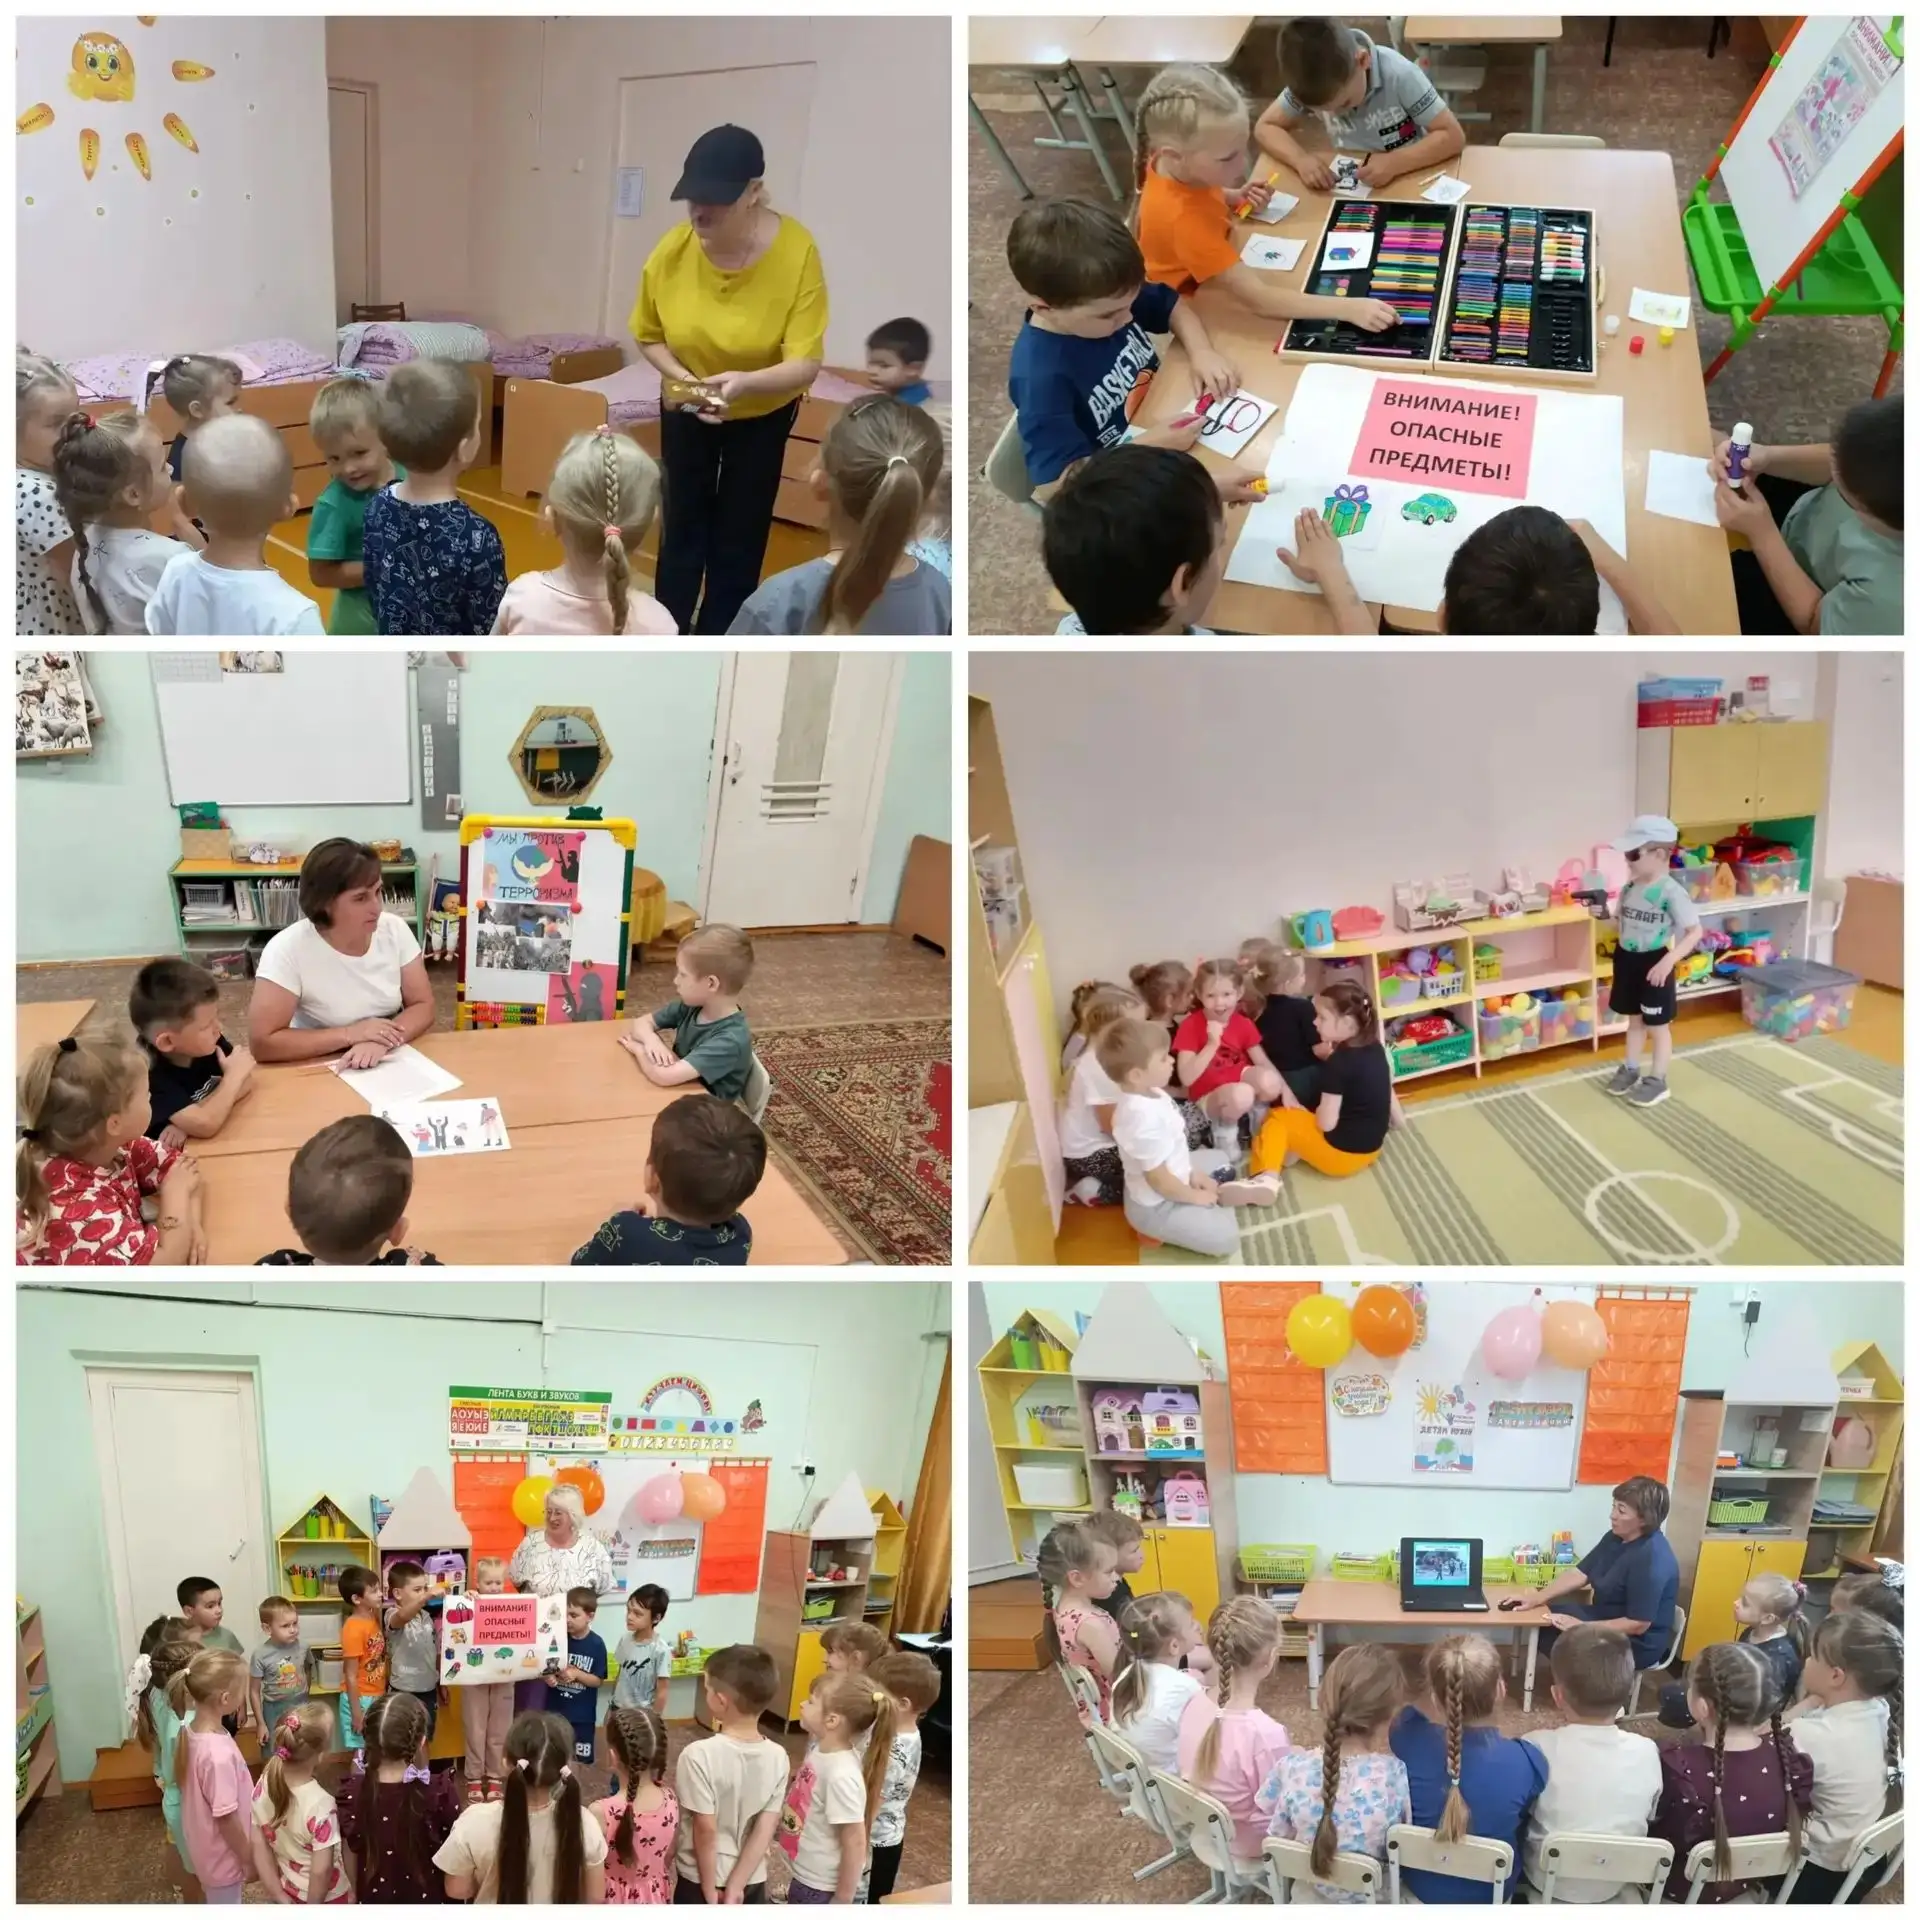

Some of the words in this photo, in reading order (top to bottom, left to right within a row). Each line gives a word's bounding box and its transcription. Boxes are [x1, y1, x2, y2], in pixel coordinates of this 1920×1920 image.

[1383, 392, 1521, 421] ВНИМАНИЕ!
[1390, 421, 1503, 448] ОПАСНЫЕ
[1369, 448, 1511, 481] ПРЕДМЕТЫ!
[496, 832, 518, 846] МЫ
[521, 832, 565, 845] ПРОТИВ
[498, 886, 573, 900] ТЕРРОРИЗМА
[488, 1388, 515, 1398] ЛЕНТА
[517, 1389, 538, 1399] БУКВ
[541, 1390, 548, 1399] И
[549, 1390, 580, 1400] ЗВУКОВ
[479, 1603, 531, 1613] ВНИМАНИЕ!
[484, 1618, 526, 1626] ОПАСНЫЕ
[479, 1630, 531, 1640] ПРЕДМЕТЫ!
